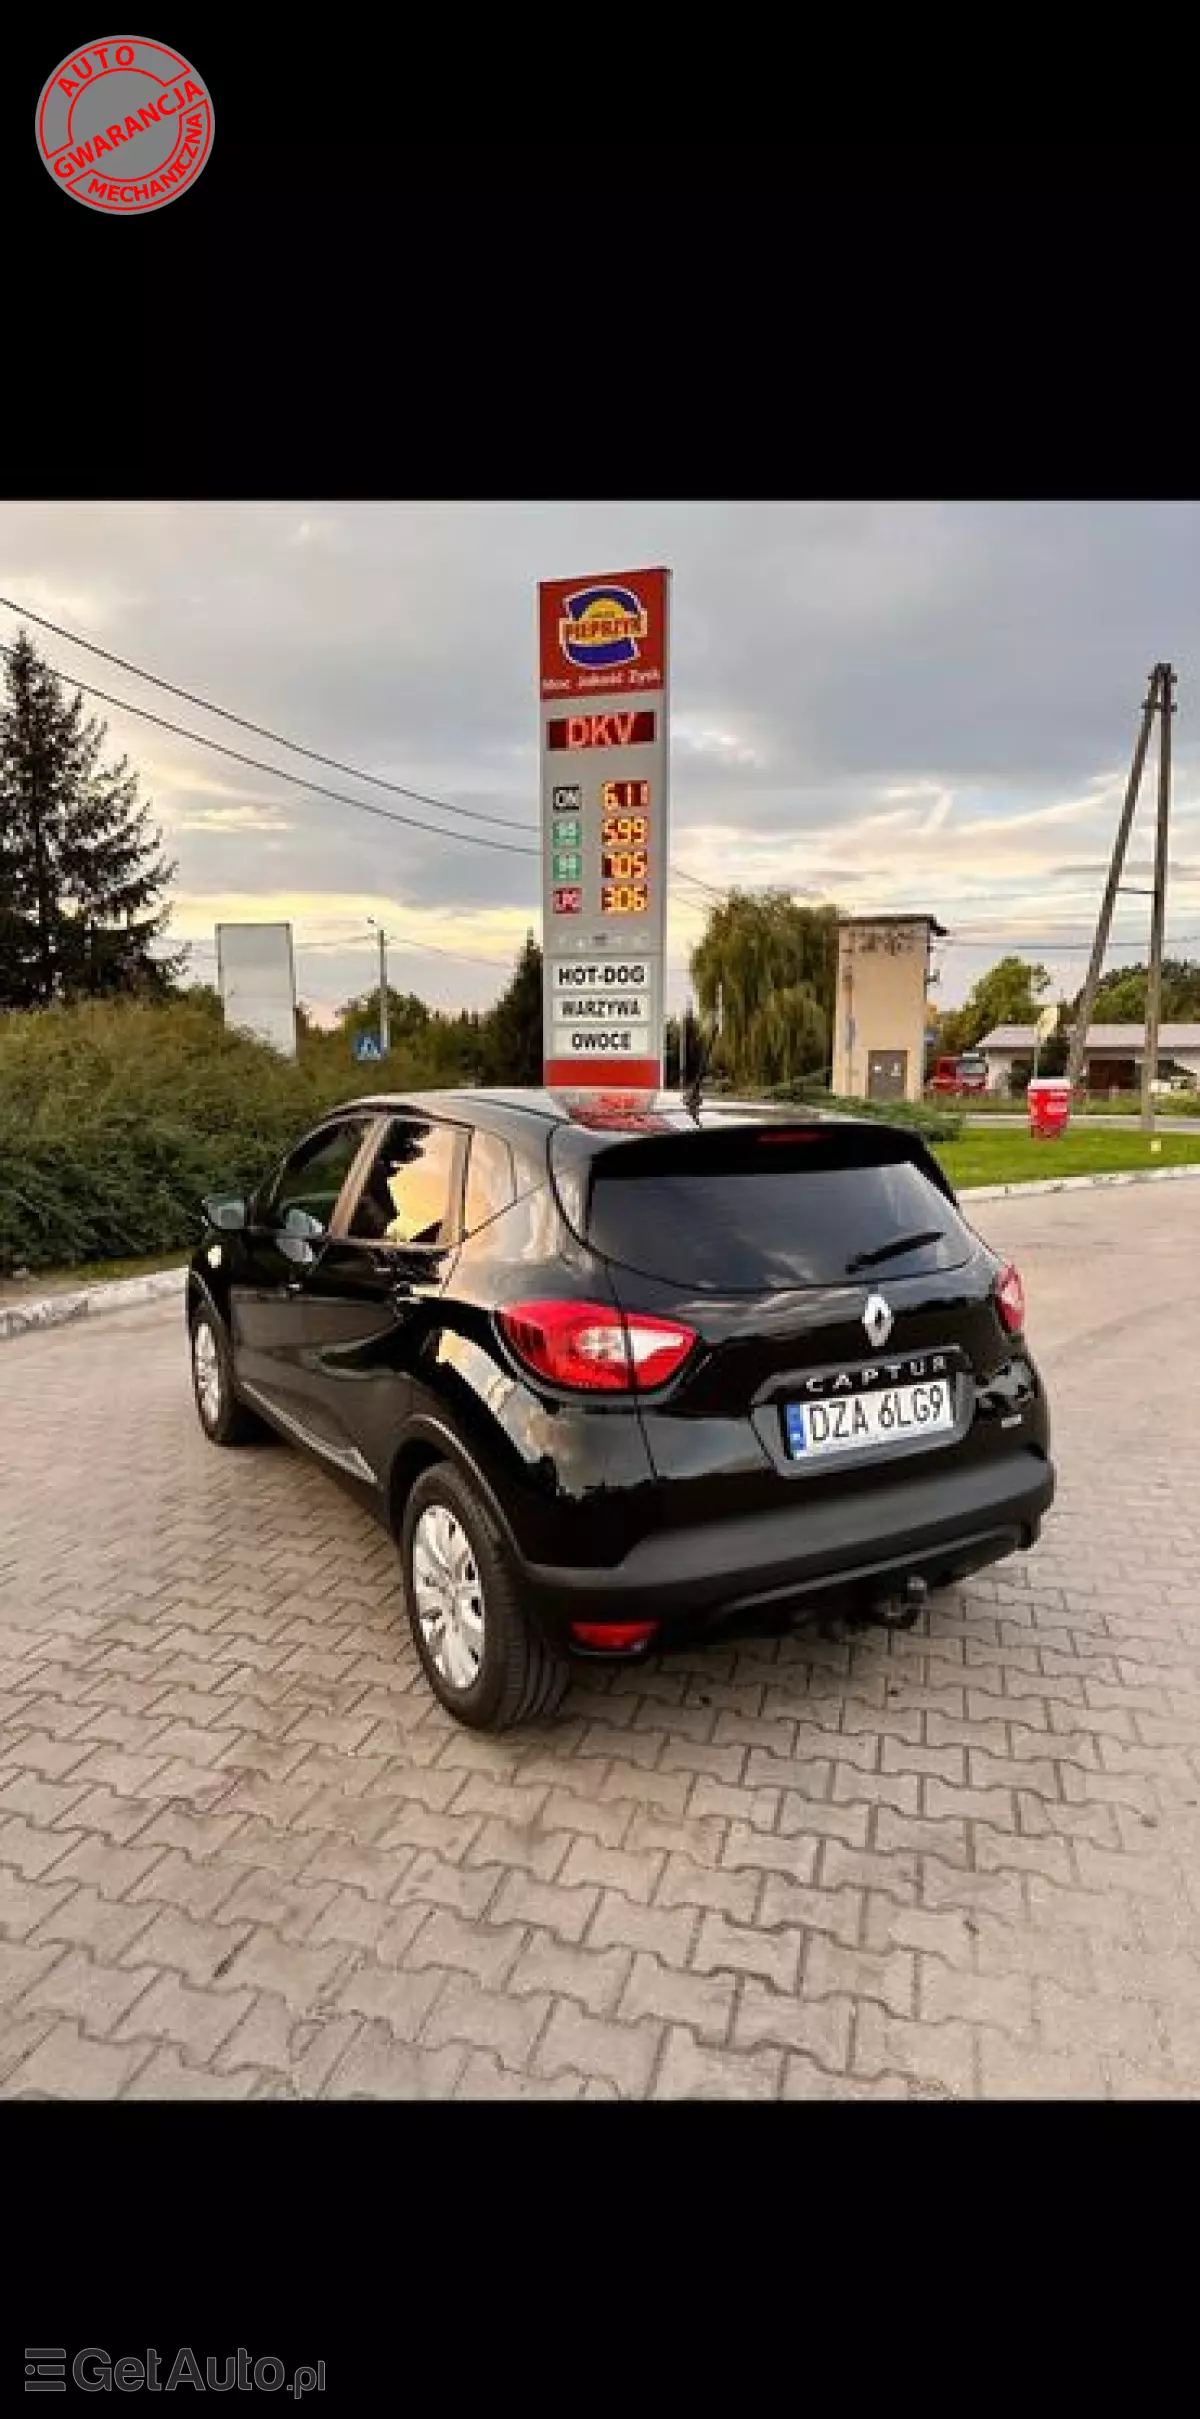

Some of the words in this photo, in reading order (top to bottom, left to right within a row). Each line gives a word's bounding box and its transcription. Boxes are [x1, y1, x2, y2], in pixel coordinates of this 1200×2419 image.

[568, 711, 635, 747] DKV
[555, 790, 579, 807] ON
[558, 965, 645, 985] HOT-DOG
[562, 999, 641, 1018] WARZYWA
[571, 1031, 632, 1050] OWOCE
[805, 1355, 948, 1392] CAPTUR
[808, 1398, 869, 1442] DZA
[878, 1384, 945, 1429] 6LG9
